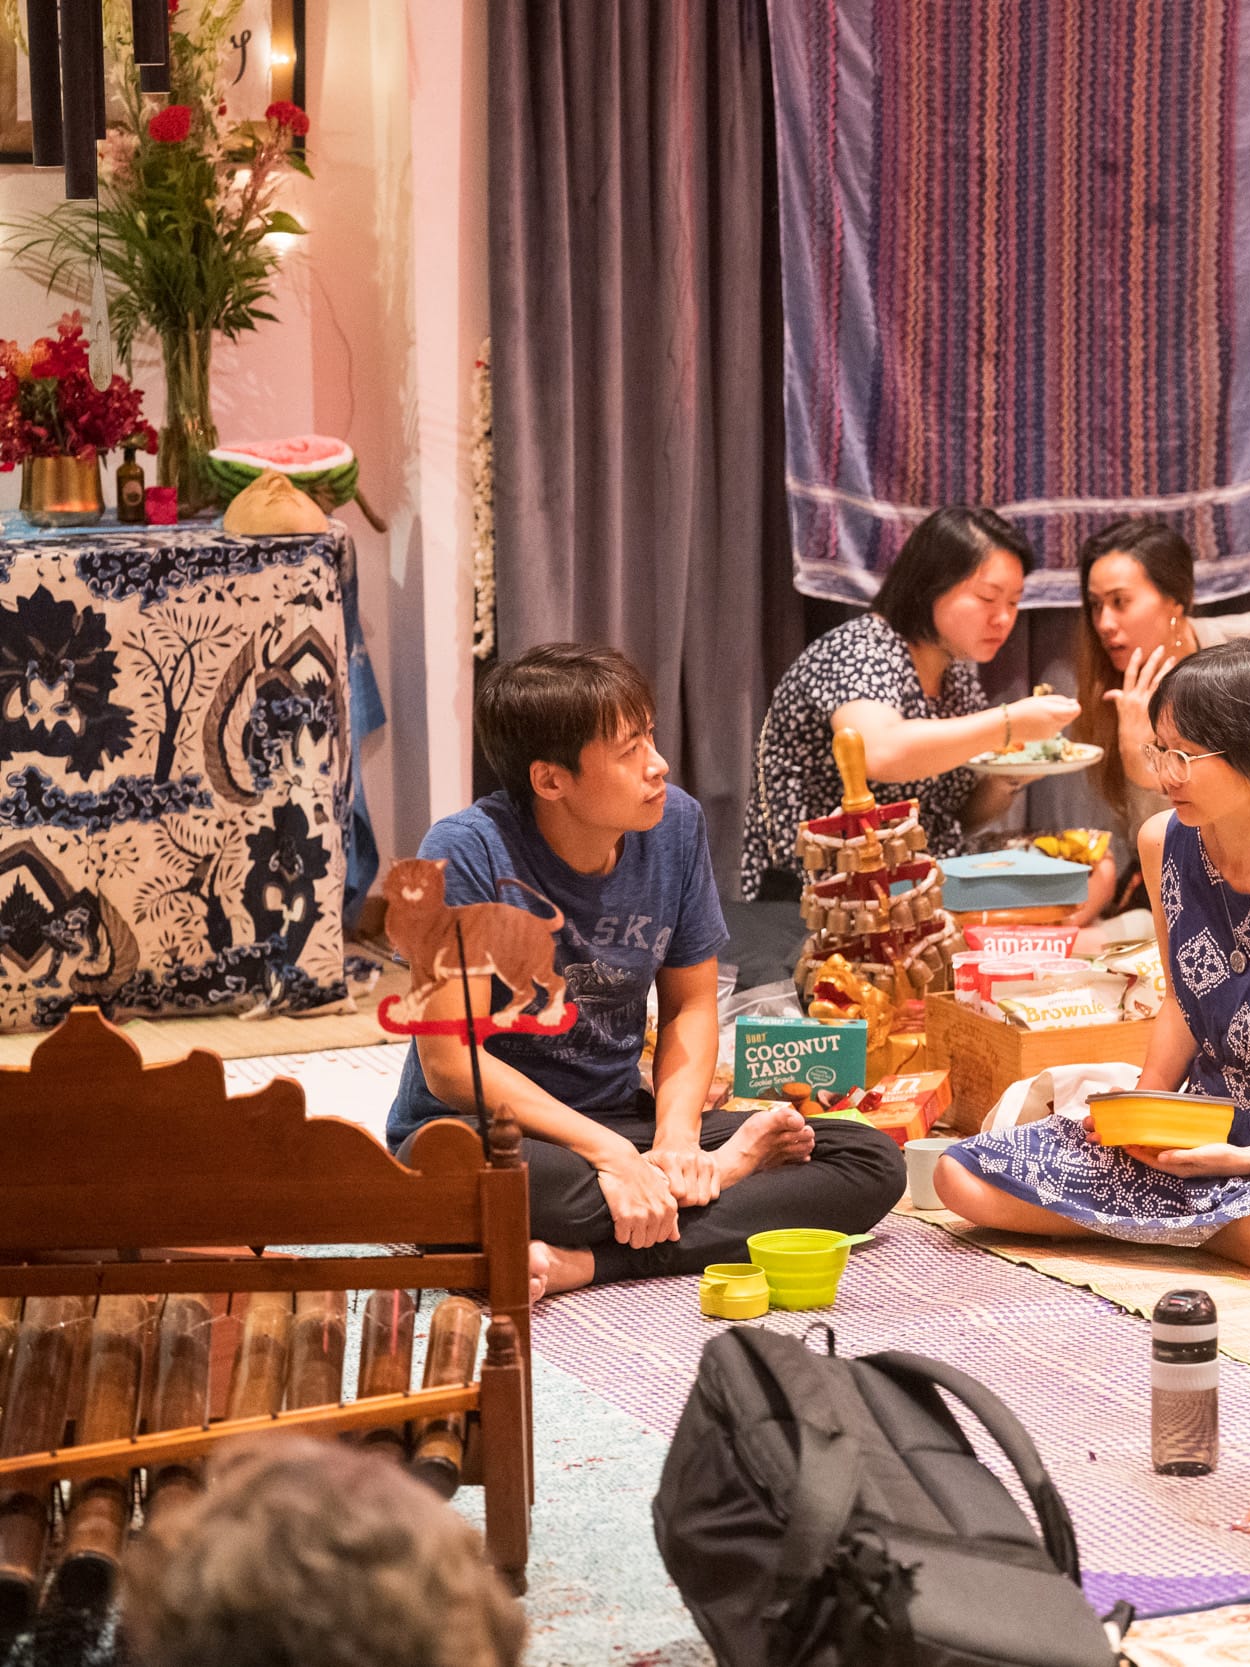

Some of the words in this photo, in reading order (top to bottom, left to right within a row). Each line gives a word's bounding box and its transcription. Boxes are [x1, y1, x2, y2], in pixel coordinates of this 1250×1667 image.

[1025, 1000, 1106, 1022] Brownie
[745, 1035, 840, 1062] COCONUT
[747, 1057, 801, 1079] TARO
